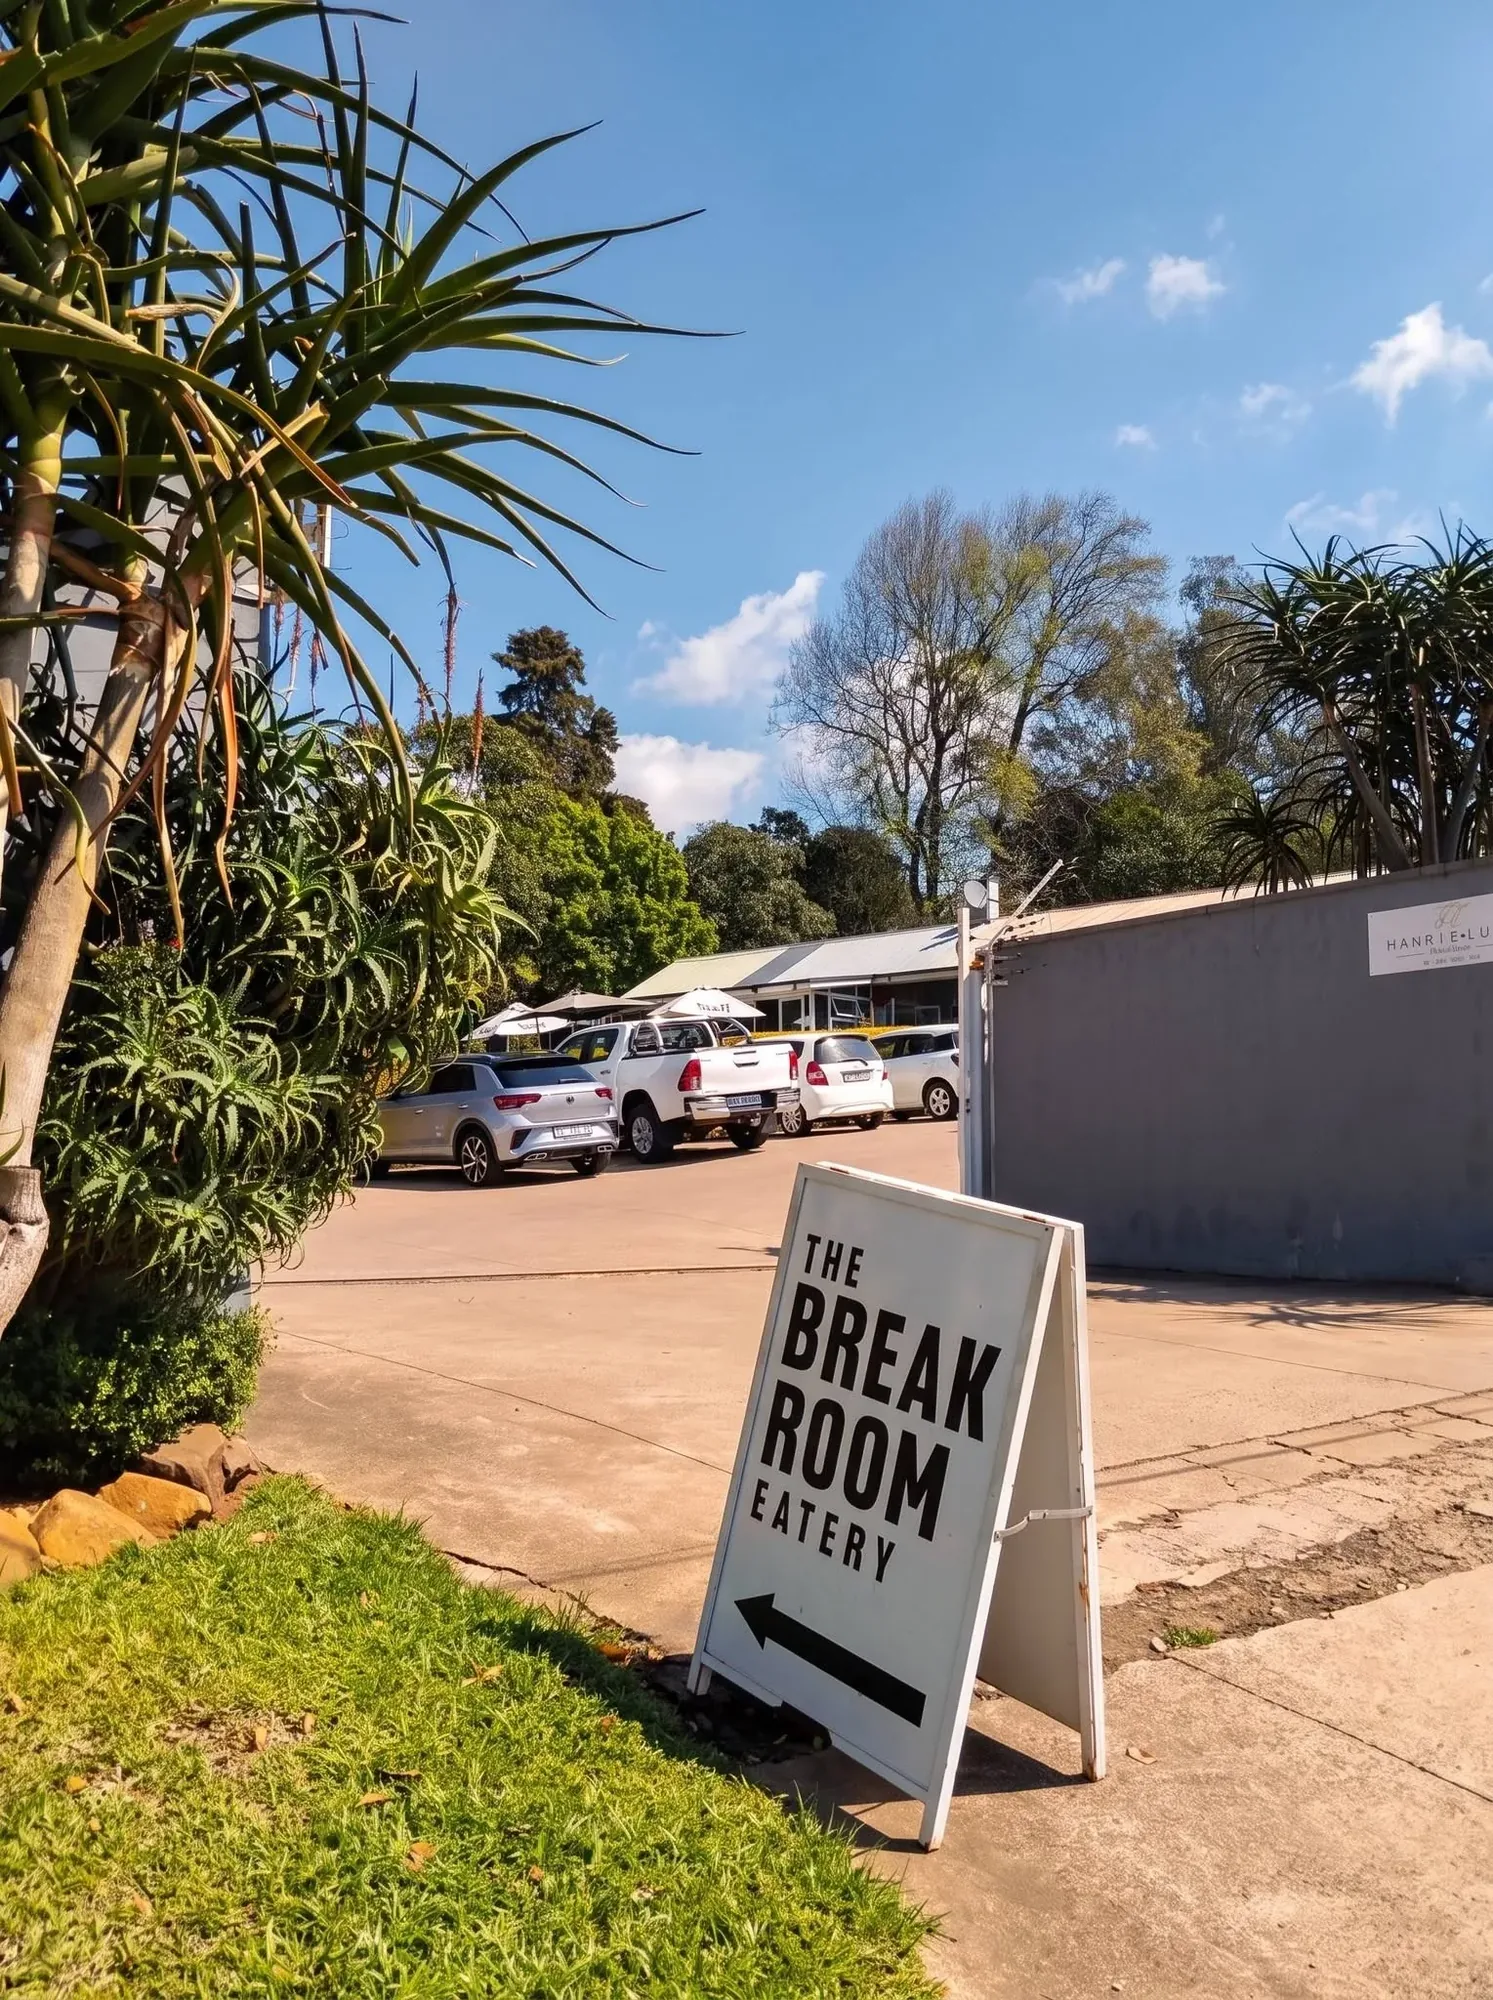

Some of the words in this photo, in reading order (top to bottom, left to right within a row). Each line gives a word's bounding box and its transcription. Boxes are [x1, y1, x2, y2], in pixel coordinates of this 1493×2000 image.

[805, 1233, 865, 1288] THE
[781, 1282, 1002, 1442] BREAK
[760, 1380, 951, 1542] ROOM
[750, 1479, 896, 1583] EATERY
